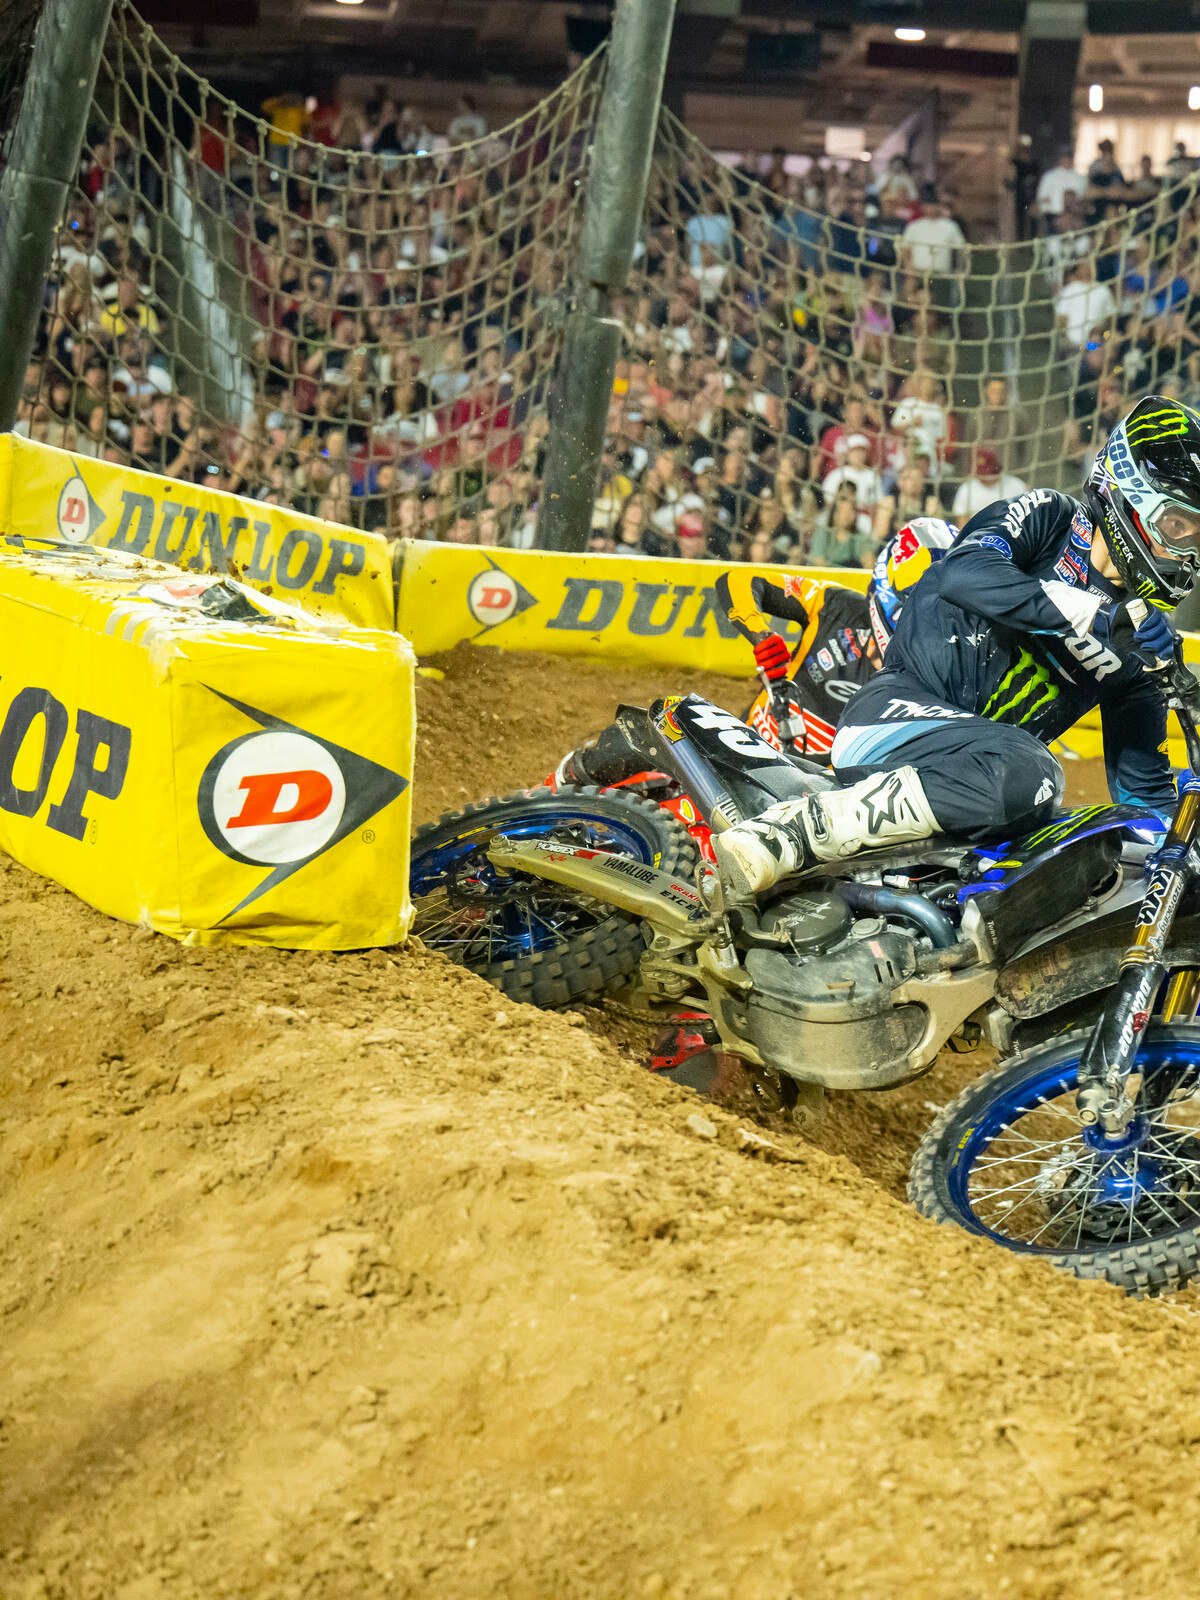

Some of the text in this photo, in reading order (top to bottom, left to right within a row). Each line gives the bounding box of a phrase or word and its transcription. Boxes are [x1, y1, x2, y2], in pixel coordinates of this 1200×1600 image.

[107, 489, 367, 597] DUNLOP
[1104, 505, 1135, 564] MONSTER
[1055, 560, 1078, 585] 100%
[1087, 585, 1112, 605] OPTIMA
[1064, 633, 1123, 682] OR
[601, 857, 660, 886] YAMALUBE
[659, 889, 702, 911] EXCE
[669, 882, 701, 903] BRAKI
